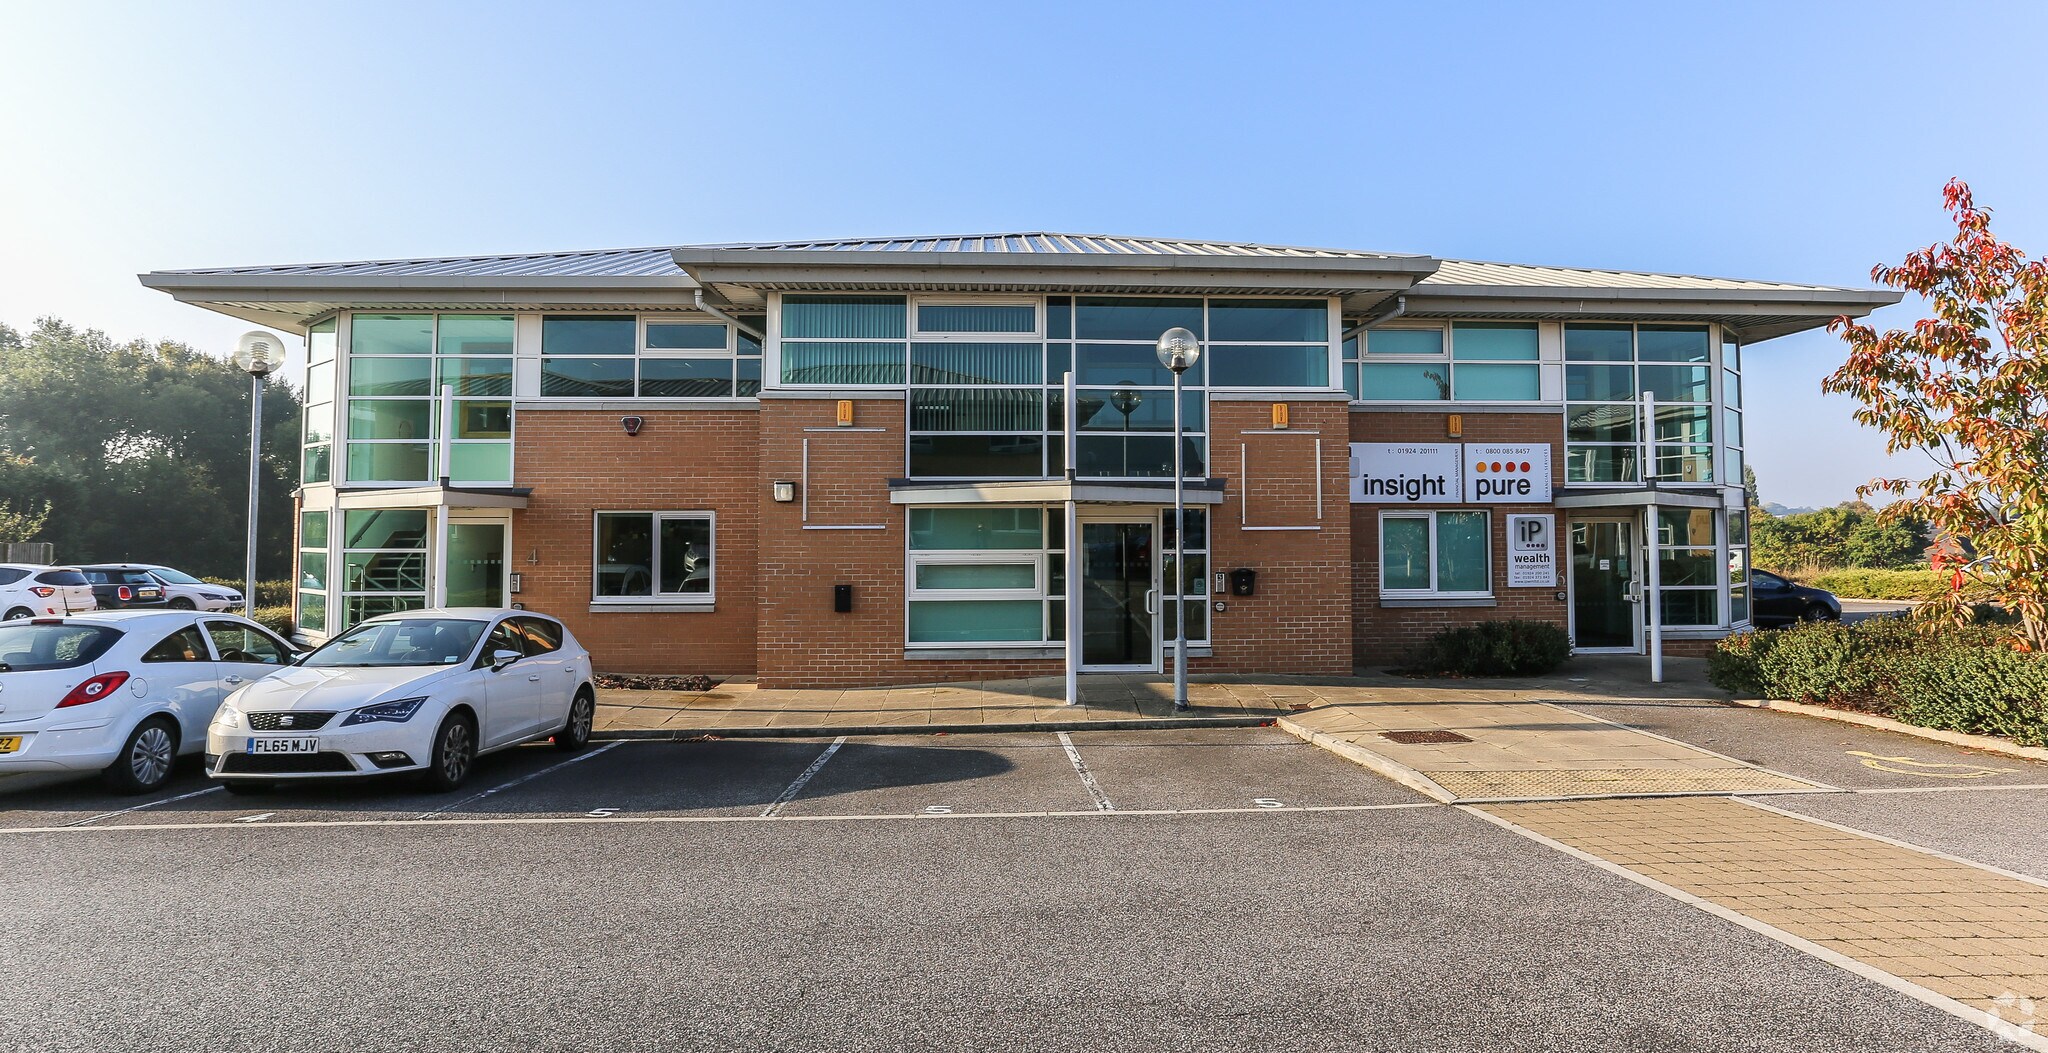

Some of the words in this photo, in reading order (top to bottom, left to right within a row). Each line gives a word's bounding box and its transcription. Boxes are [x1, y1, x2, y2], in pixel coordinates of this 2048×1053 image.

[1363, 473, 1446, 501] insight
[1476, 478, 1531, 501] pure
[1521, 521, 1542, 541] iP
[527, 549, 538, 566] 4
[1514, 553, 1550, 562] wealth
[1556, 568, 1566, 586] 6
[255, 740, 289, 752] FL65
[291, 739, 317, 752] MJV
[585, 807, 621, 818] 5
